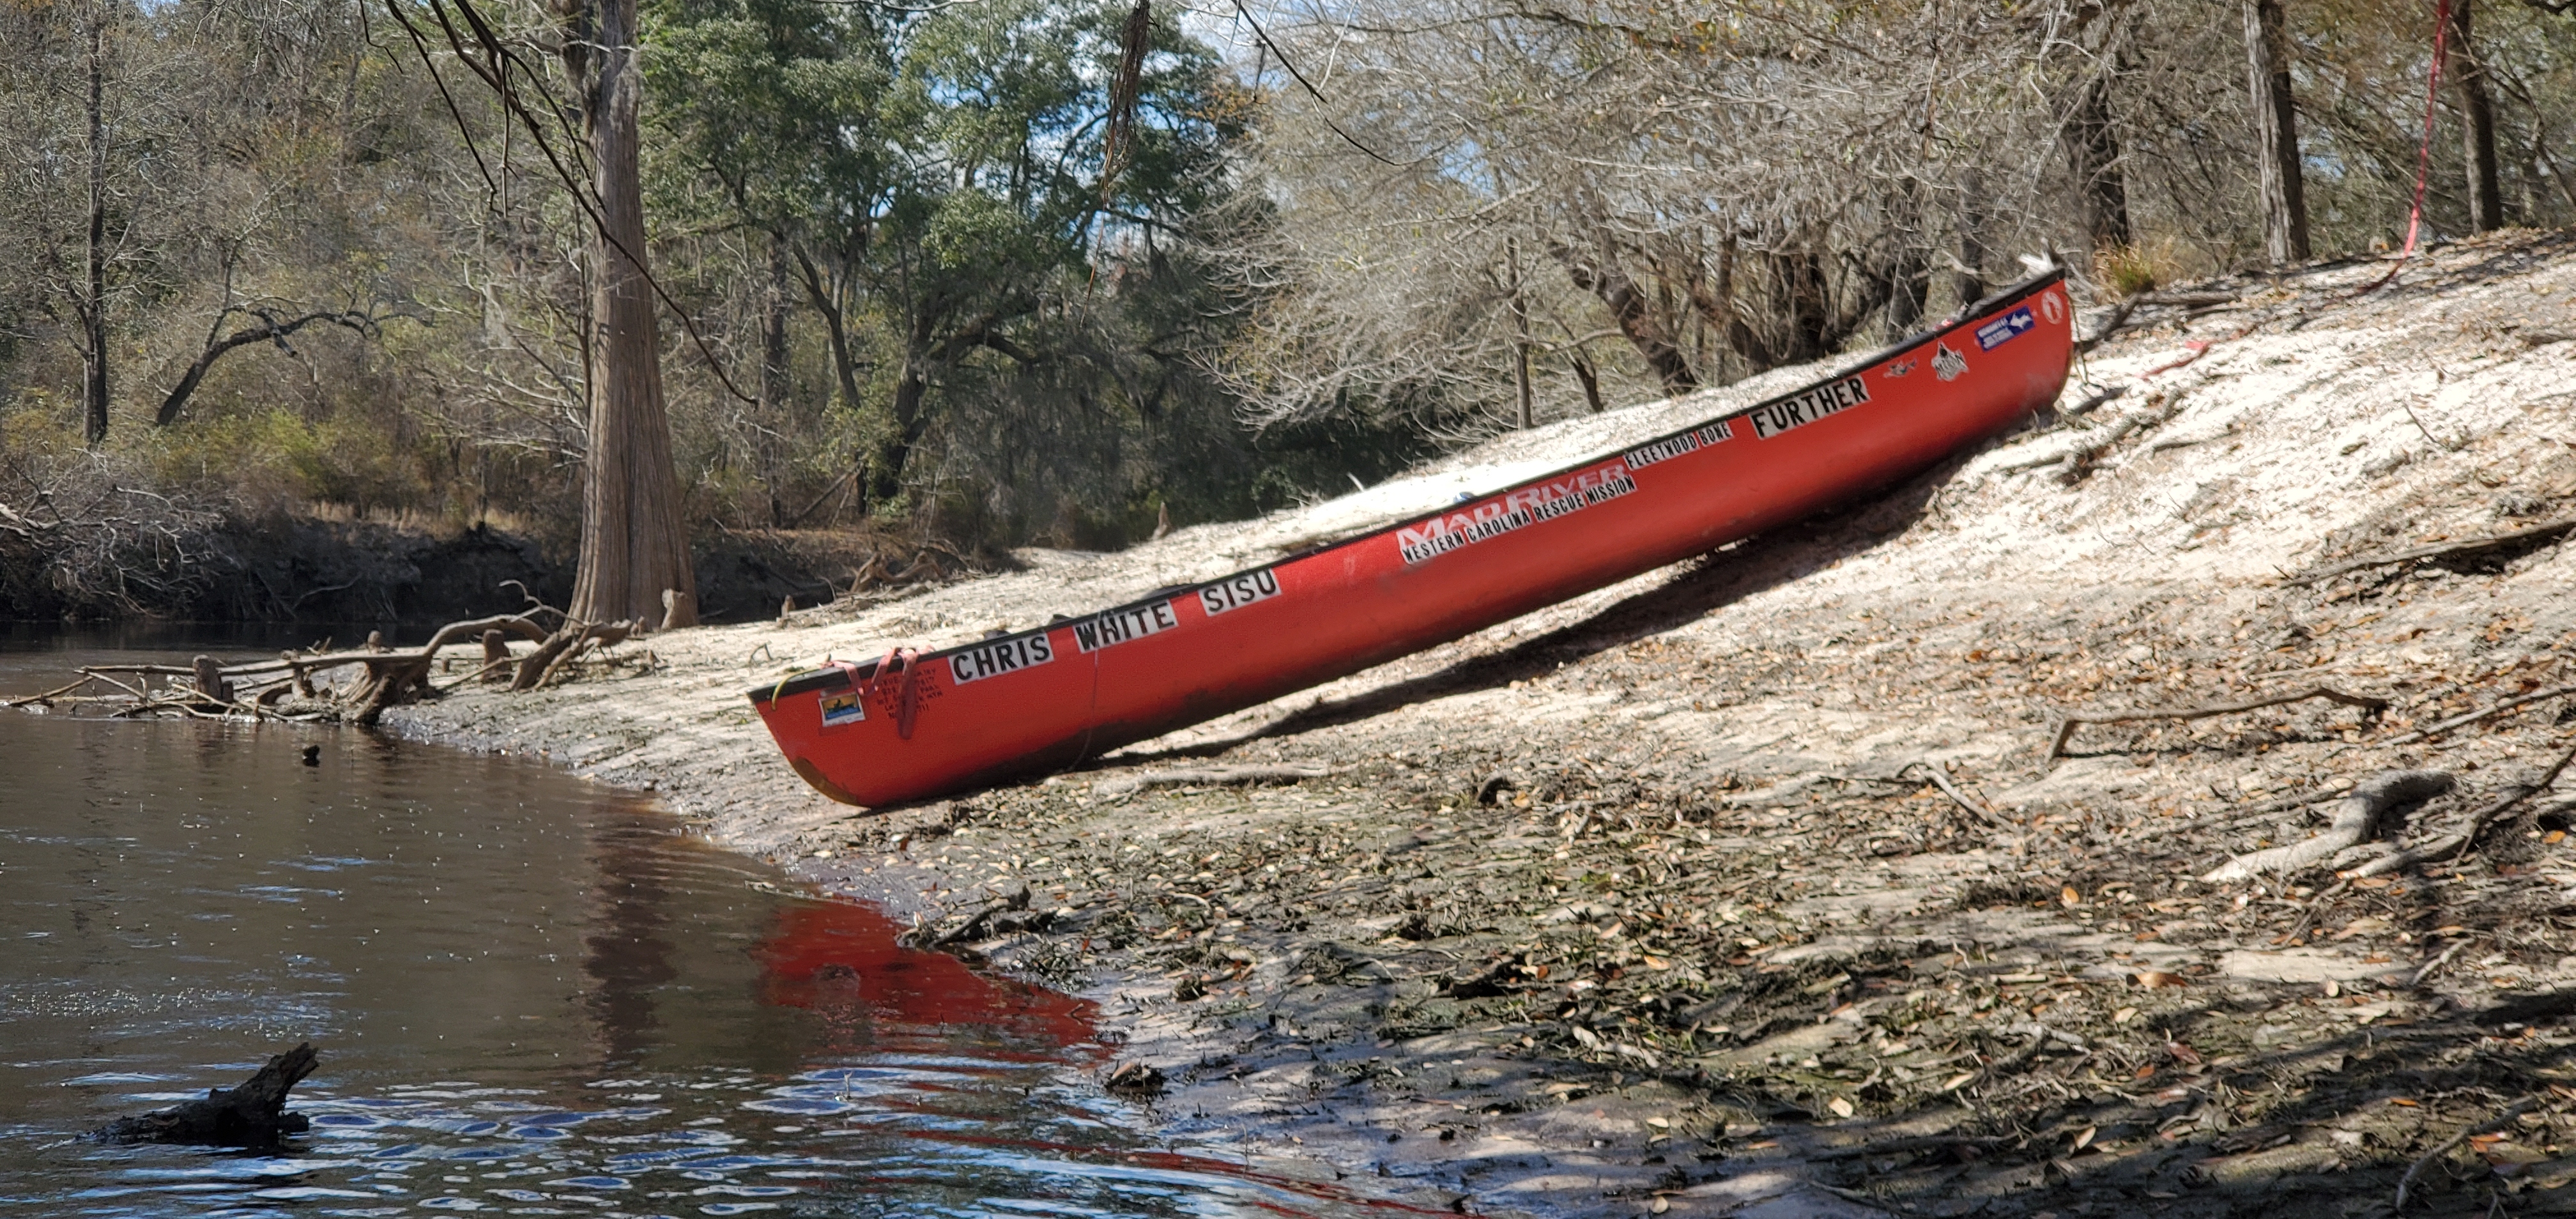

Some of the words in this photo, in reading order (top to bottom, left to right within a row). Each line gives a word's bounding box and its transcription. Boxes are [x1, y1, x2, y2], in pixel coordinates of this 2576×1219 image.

[1625, 434, 1698, 469] FLEETWOOD
[1699, 424, 1731, 445] BONE
[1751, 378, 1867, 438] FURTHER
[1397, 502, 1500, 548] MAD
[1506, 464, 1625, 513] RIVER
[1402, 530, 1464, 562] WESTERN
[1467, 509, 1531, 542] CAROLINA
[1533, 493, 1584, 521] RESCUE
[1585, 476, 1636, 504] MISSION
[953, 636, 1050, 681] CHRIS
[1075, 601, 1175, 650] WHITE
[1204, 573, 1277, 613] SISU
